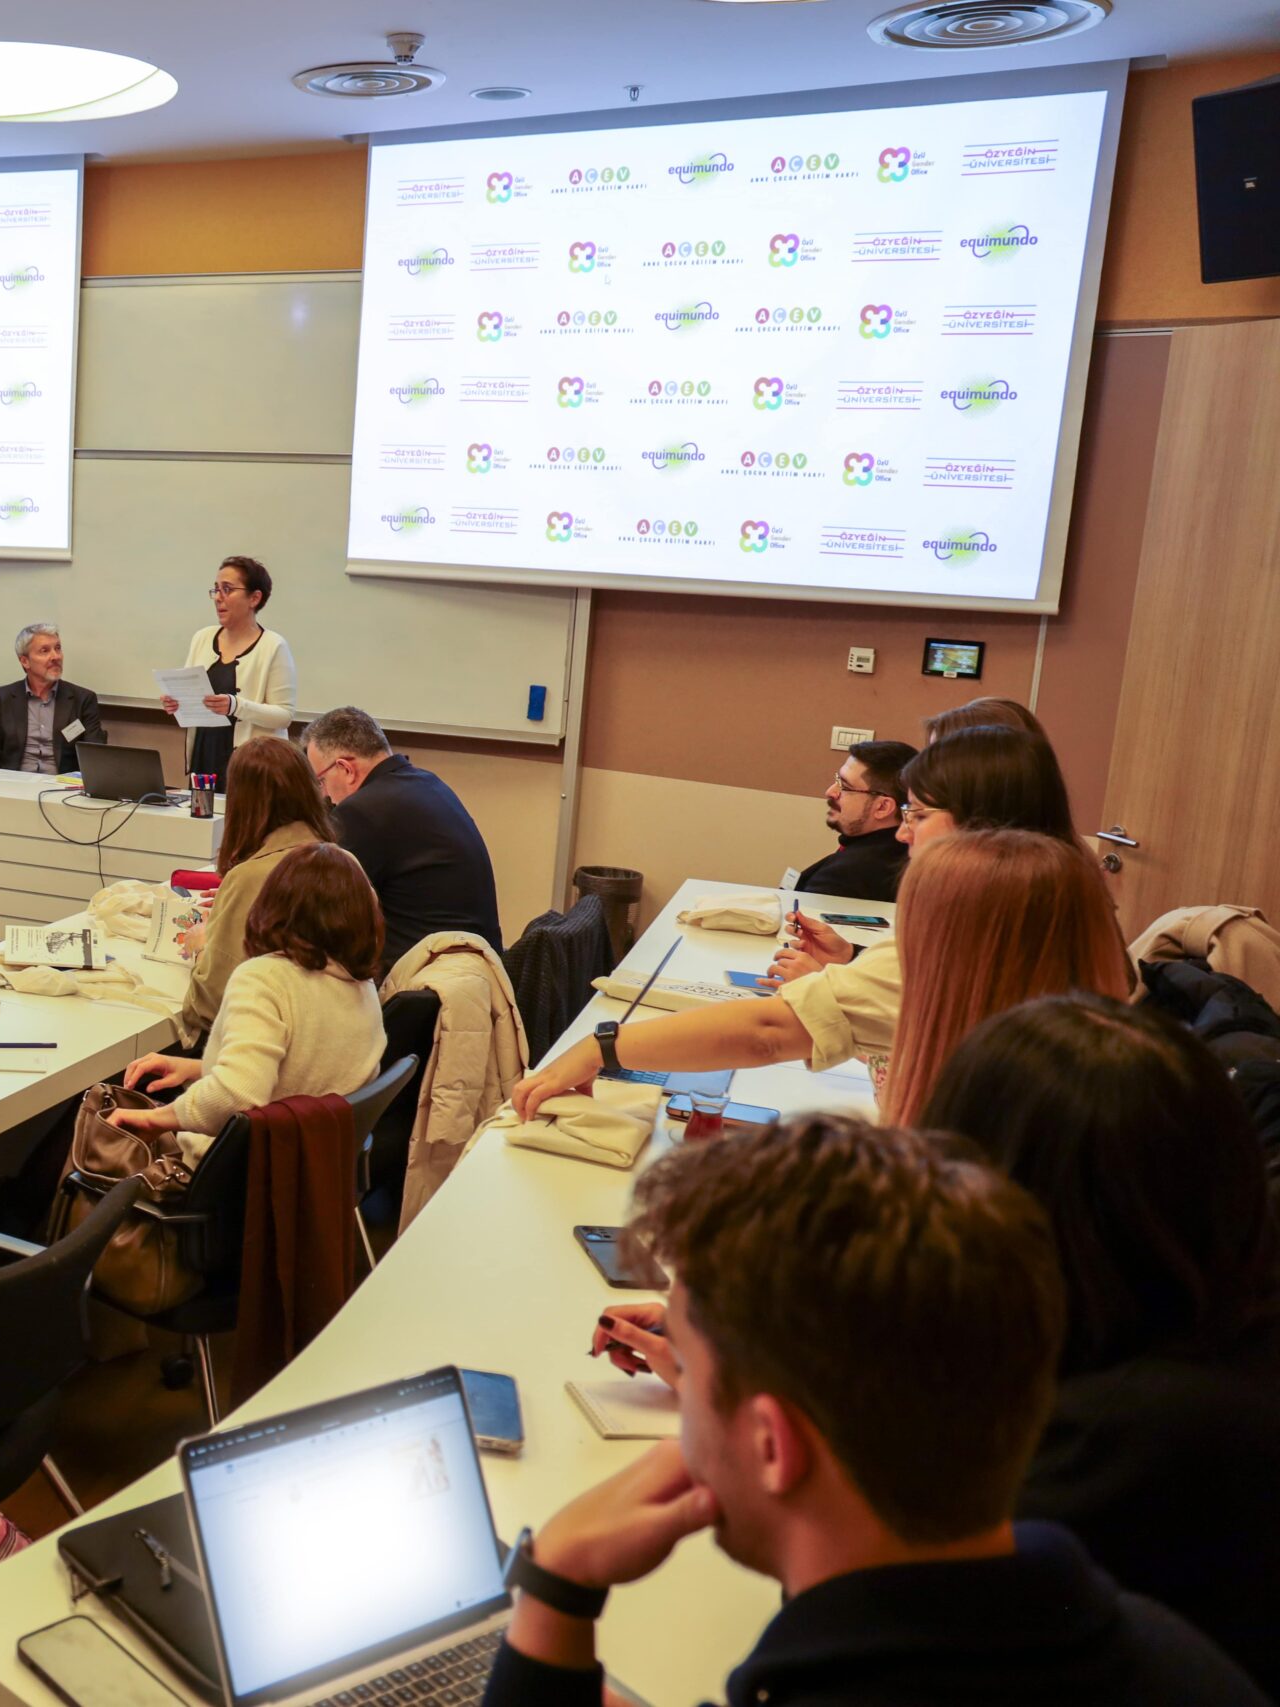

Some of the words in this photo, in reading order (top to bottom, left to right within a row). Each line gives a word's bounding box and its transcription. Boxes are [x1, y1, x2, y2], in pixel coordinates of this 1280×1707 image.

[969, 155, 1049, 168] ÜNİVERSİTESİ
[985, 147, 1036, 158] ÖZYEĞİN
[668, 153, 734, 184] equimundo
[960, 225, 1038, 258] equimundo
[398, 248, 454, 275] equimundo
[655, 302, 719, 330] equimundo
[963, 310, 1014, 319] ÖZYEĞİN
[390, 378, 445, 404] equimundo
[941, 380, 1017, 410] equimundo
[642, 442, 705, 469] equimundo
[945, 463, 994, 472] ÖZYEĞİN
[381, 507, 435, 531] equimundo
[922, 532, 997, 560] equimundo
